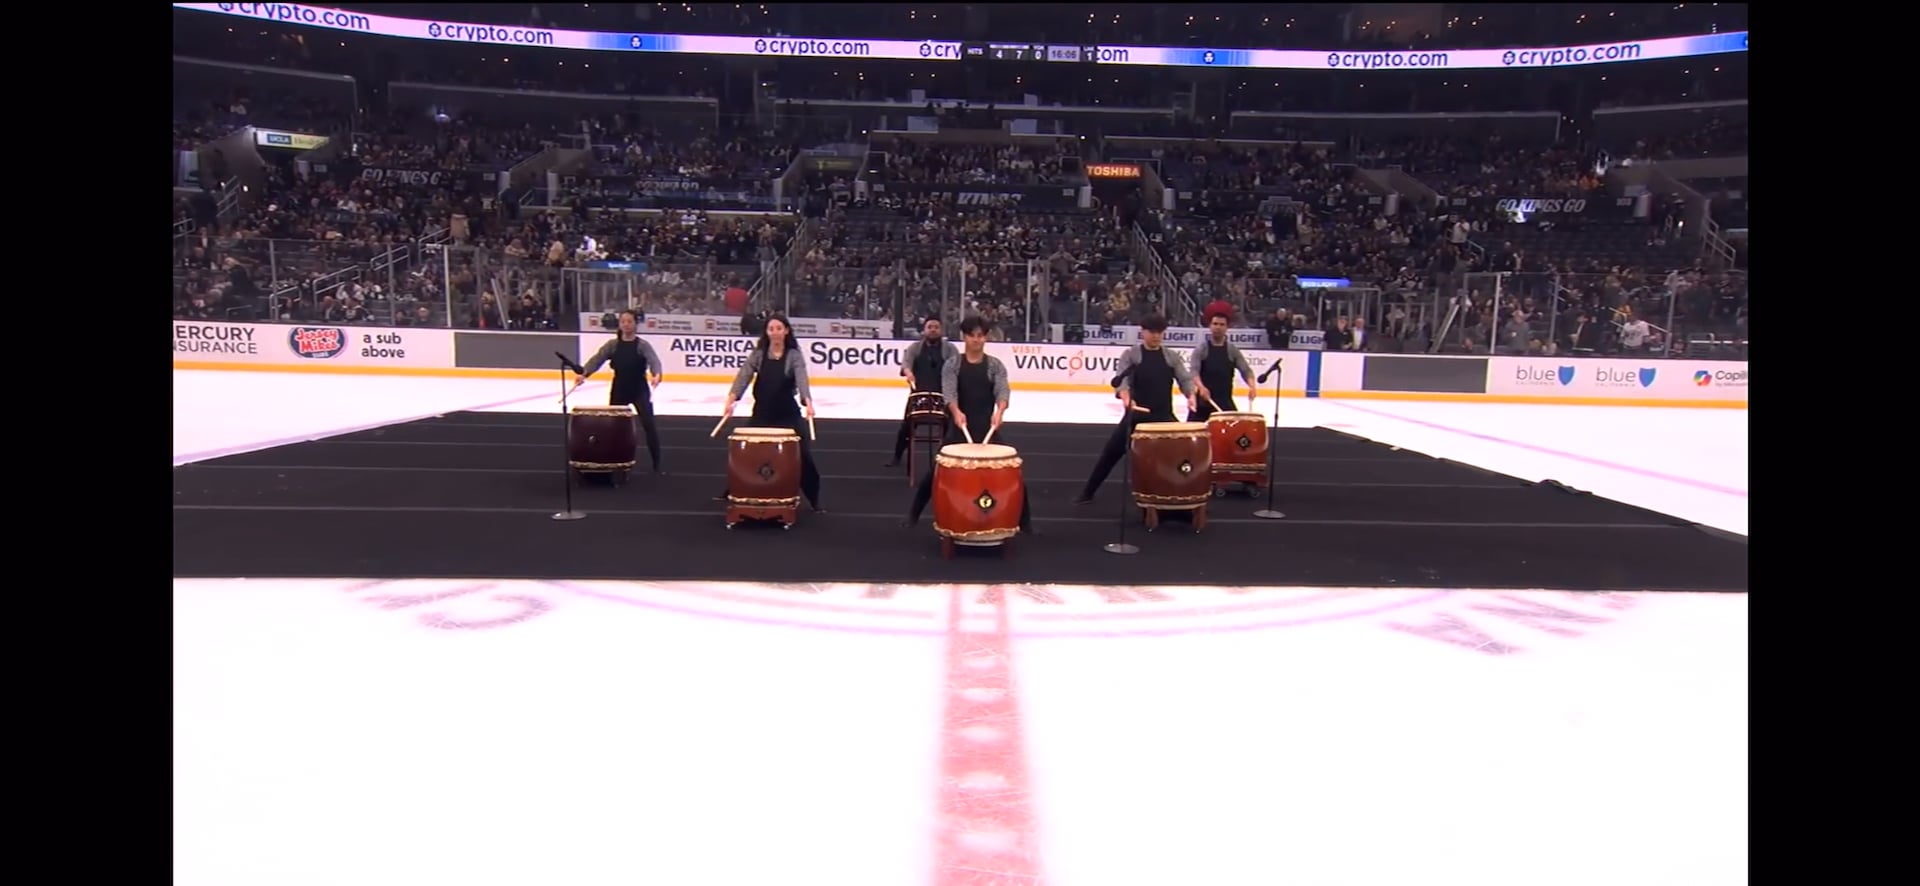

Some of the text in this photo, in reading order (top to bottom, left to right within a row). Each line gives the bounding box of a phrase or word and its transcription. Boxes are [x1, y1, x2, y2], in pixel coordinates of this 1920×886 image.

[239, 3, 370, 30] crypto.com
[445, 24, 553, 44] crypto.com
[769, 39, 870, 55] crypto.com
[1519, 43, 1641, 65] crypto.com
[1342, 52, 1448, 68] crypto.com
[1086, 165, 1141, 177] TOSHIBA
[1563, 200, 1587, 213] GO
[175, 325, 255, 341] ERCURY
[363, 332, 402, 344] a sub
[1092, 330, 1124, 339] LIGHT
[1163, 332, 1194, 341] LIGHT
[1230, 334, 1262, 343] LIGHT
[173, 339, 257, 354] SURANCE
[361, 346, 405, 358] above
[670, 338, 756, 353] AMERICA
[685, 354, 747, 368] EXPRE
[810, 341, 902, 369] Spectru
[1014, 355, 1119, 371] VANCOUVE
[1516, 366, 1556, 380] blue
[1596, 368, 1636, 382] blue
